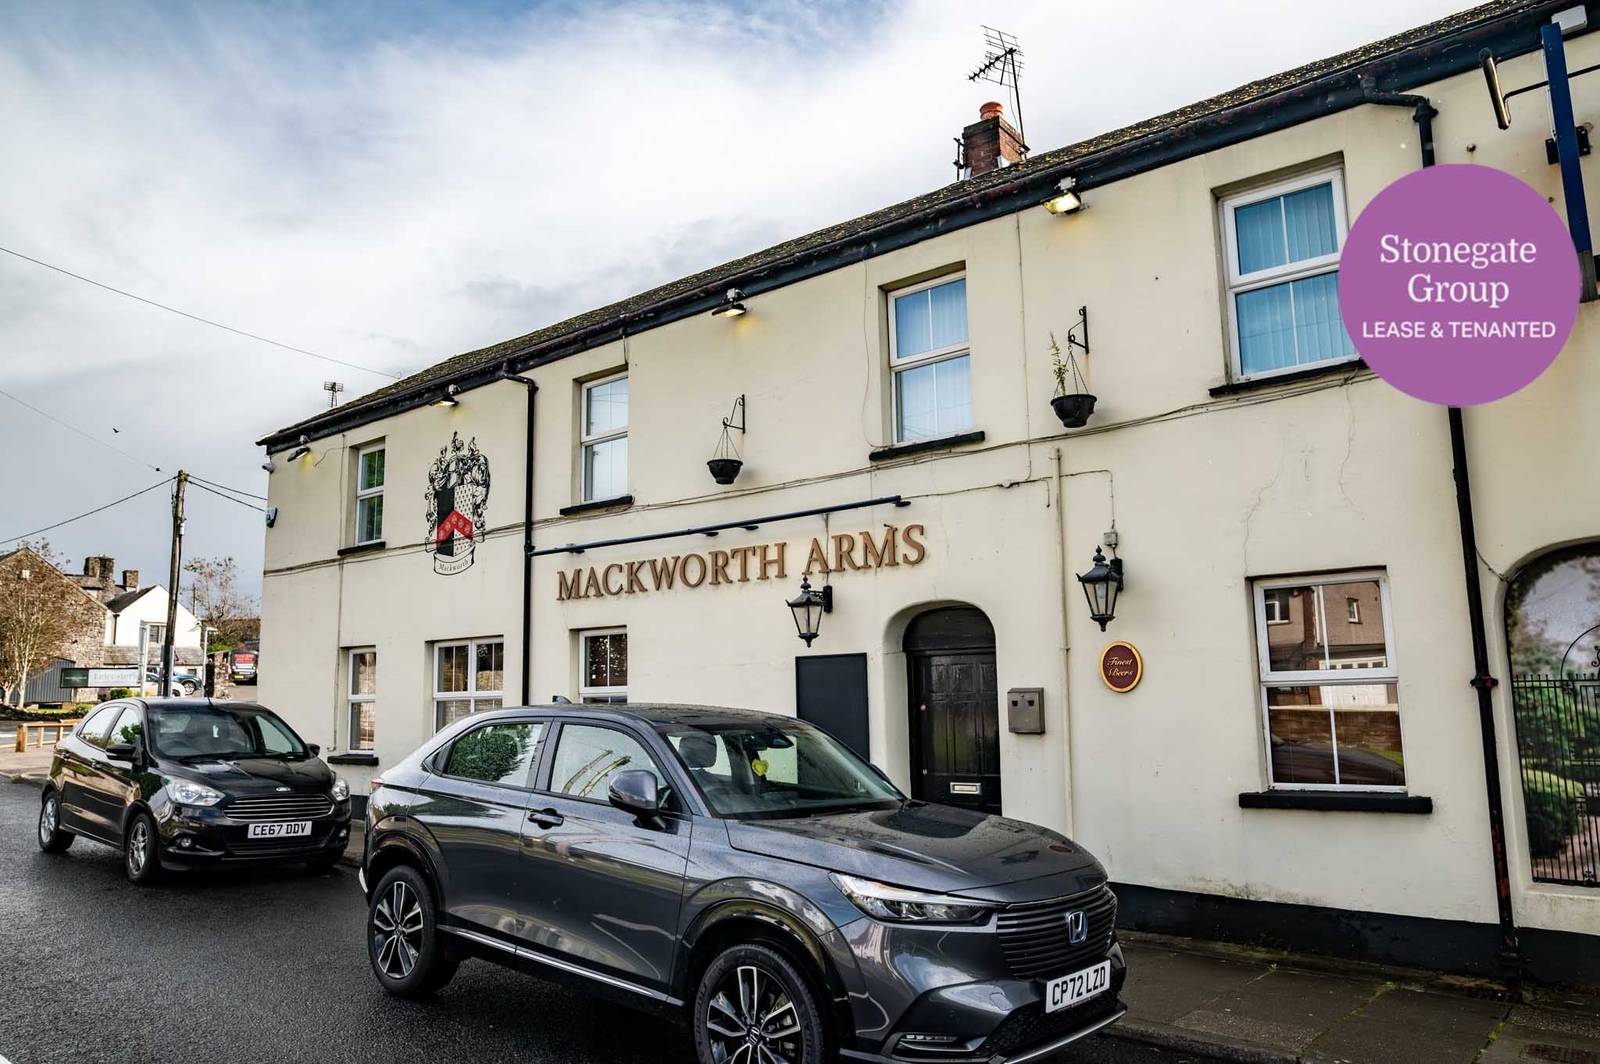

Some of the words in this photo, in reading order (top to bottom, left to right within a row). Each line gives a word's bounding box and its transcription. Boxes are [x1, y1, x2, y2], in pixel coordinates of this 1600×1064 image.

[556, 541, 788, 601] MACKWORTH
[801, 523, 926, 576] ARMS
[1107, 656, 1133, 666] Finest
[1108, 667, 1134, 677] Beers
[253, 824, 283, 836] CE67
[285, 823, 307, 835] DDV
[1052, 975, 1083, 1006] CP72
[1086, 966, 1106, 993] LZD
